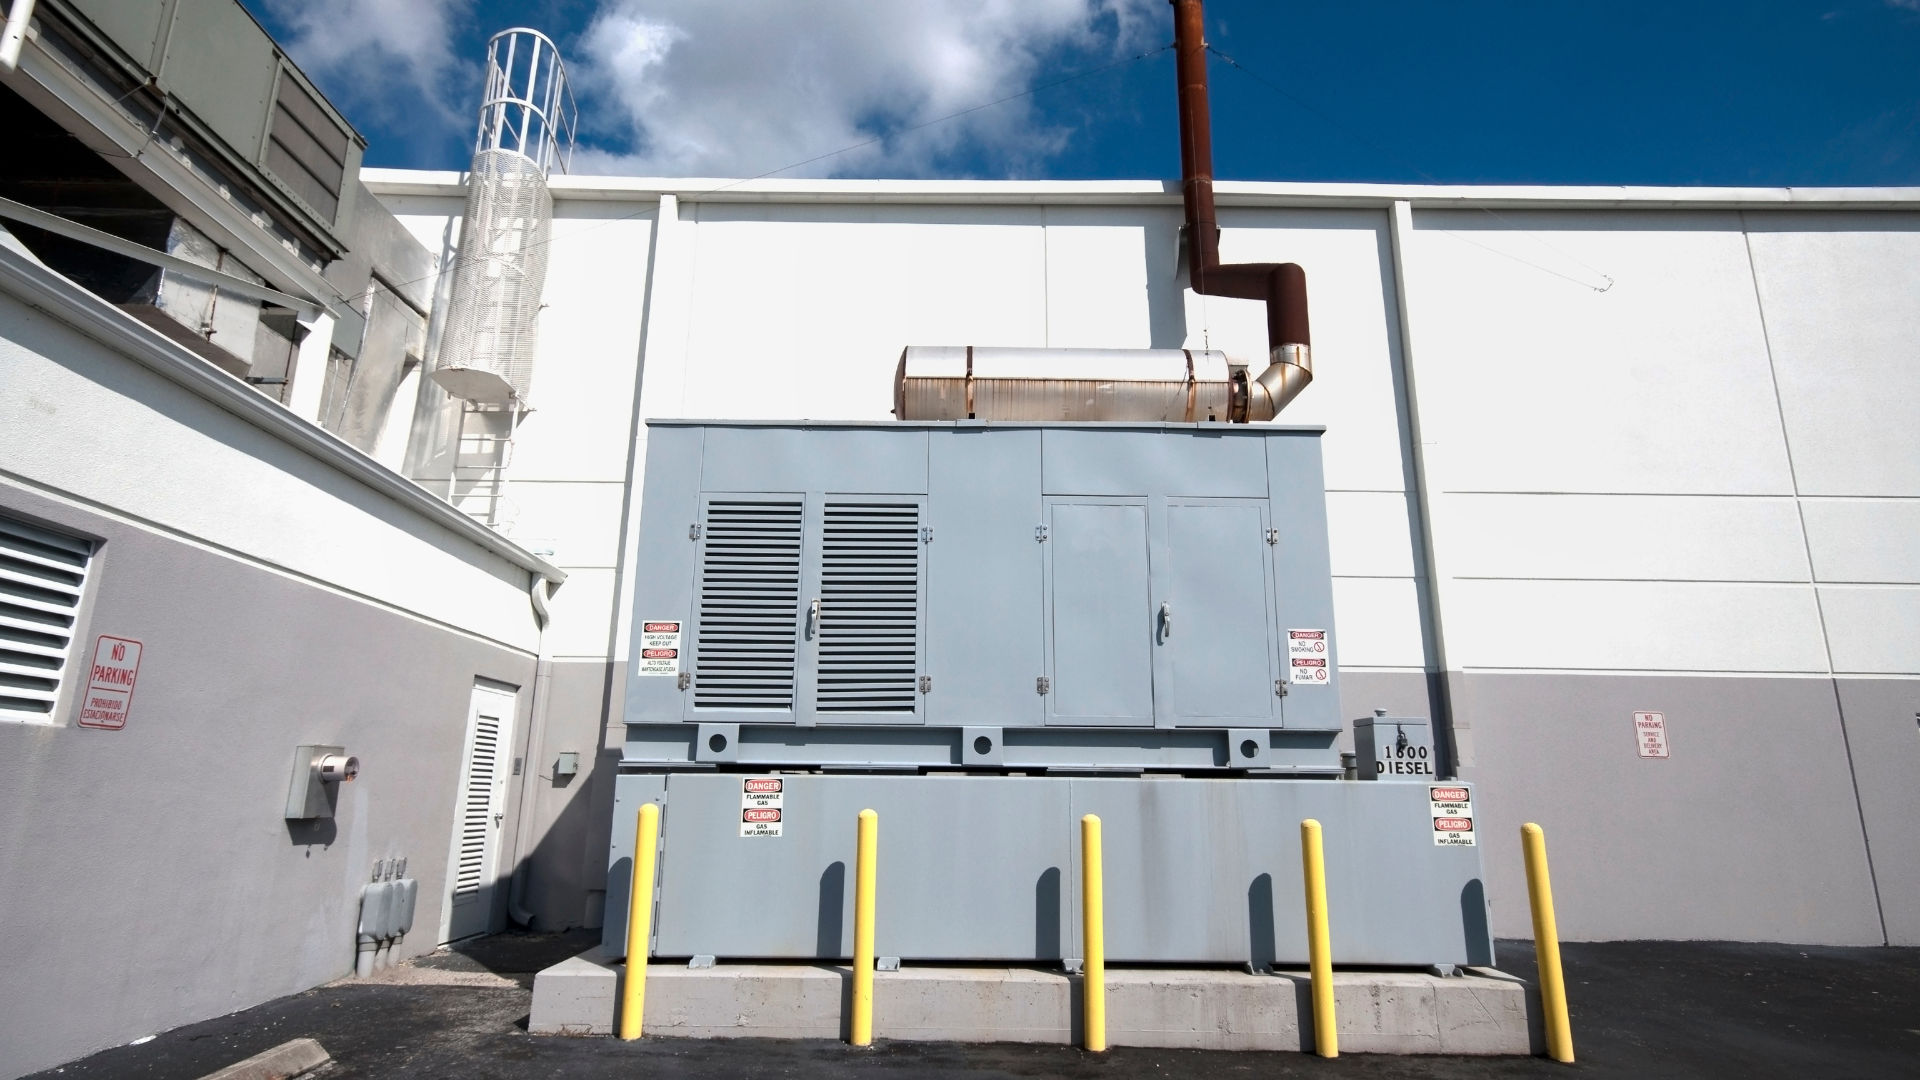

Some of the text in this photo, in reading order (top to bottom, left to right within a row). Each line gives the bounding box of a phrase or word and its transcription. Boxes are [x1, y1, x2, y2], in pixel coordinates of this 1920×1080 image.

[111, 644, 125, 661] NO
[92, 665, 134, 686] PARKING
[90, 698, 122, 710] PROHIBIDO
[83, 709, 124, 722] ESTACIONARSE
[1385, 746, 1427, 759] 1600
[1376, 761, 1433, 774] DIESEL
[1434, 791, 1466, 799] DANGER
[1438, 821, 1468, 829] PELIGRO
